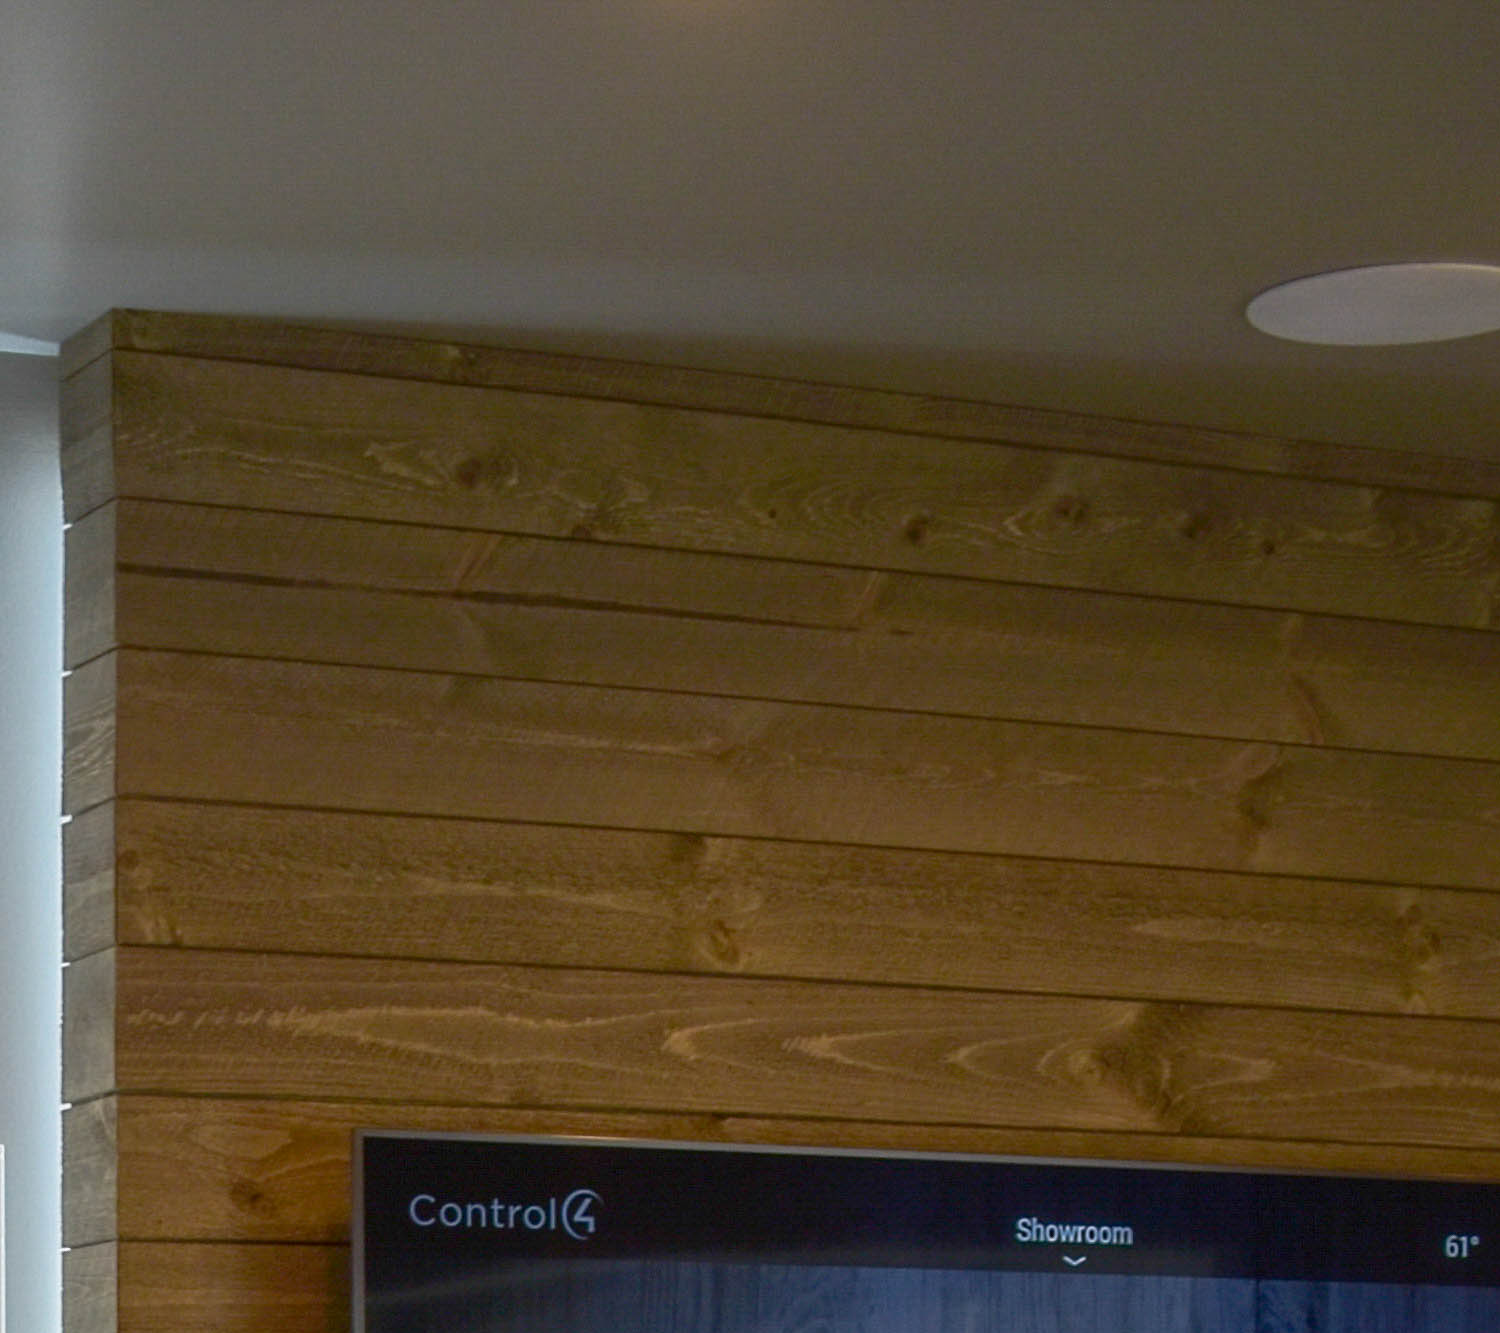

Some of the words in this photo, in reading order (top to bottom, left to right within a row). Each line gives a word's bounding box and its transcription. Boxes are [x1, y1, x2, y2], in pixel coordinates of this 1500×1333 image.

[408, 1188, 604, 1241] Control4
[1016, 1217, 1134, 1246] Showroom
[1444, 1234, 1481, 1258] 61°
